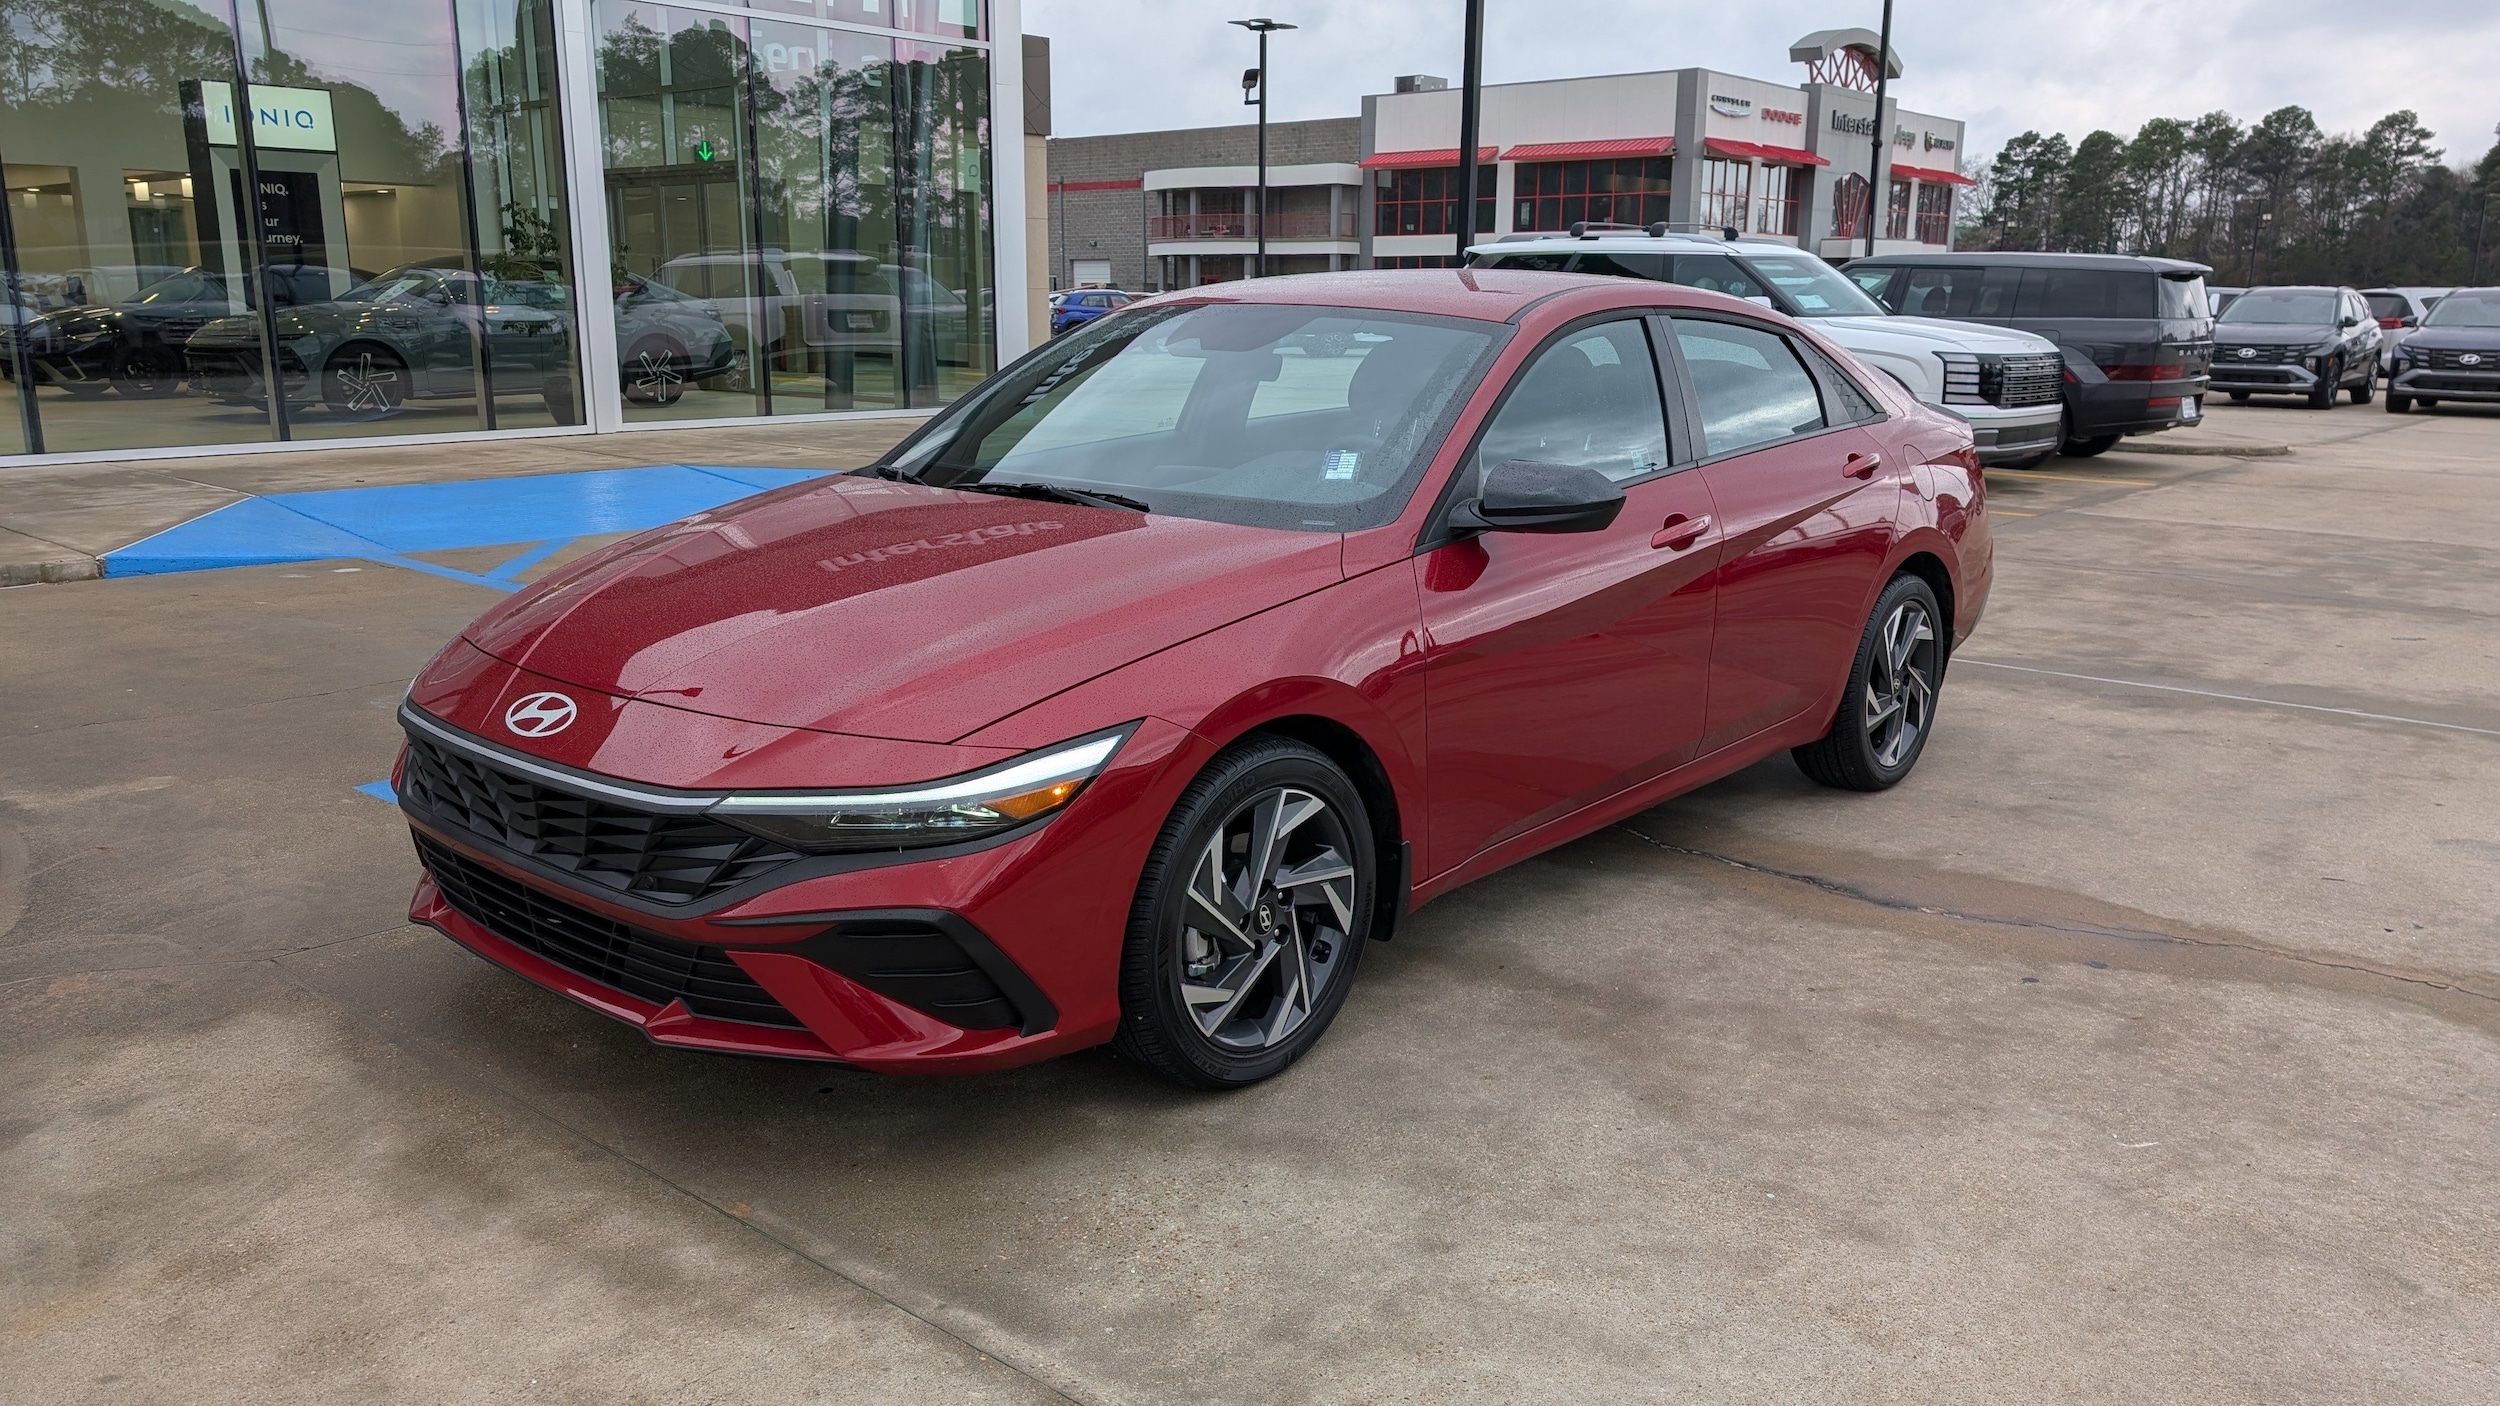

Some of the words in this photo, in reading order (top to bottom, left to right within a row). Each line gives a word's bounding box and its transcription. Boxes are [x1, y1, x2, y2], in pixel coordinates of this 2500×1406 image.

[1711, 94, 1752, 108] CHRYSLER
[224, 105, 314, 129] INIQ
[1761, 108, 1802, 125] DODGE
[1832, 110, 1876, 136] Intersta
[260, 183, 288, 196] NIQ.
